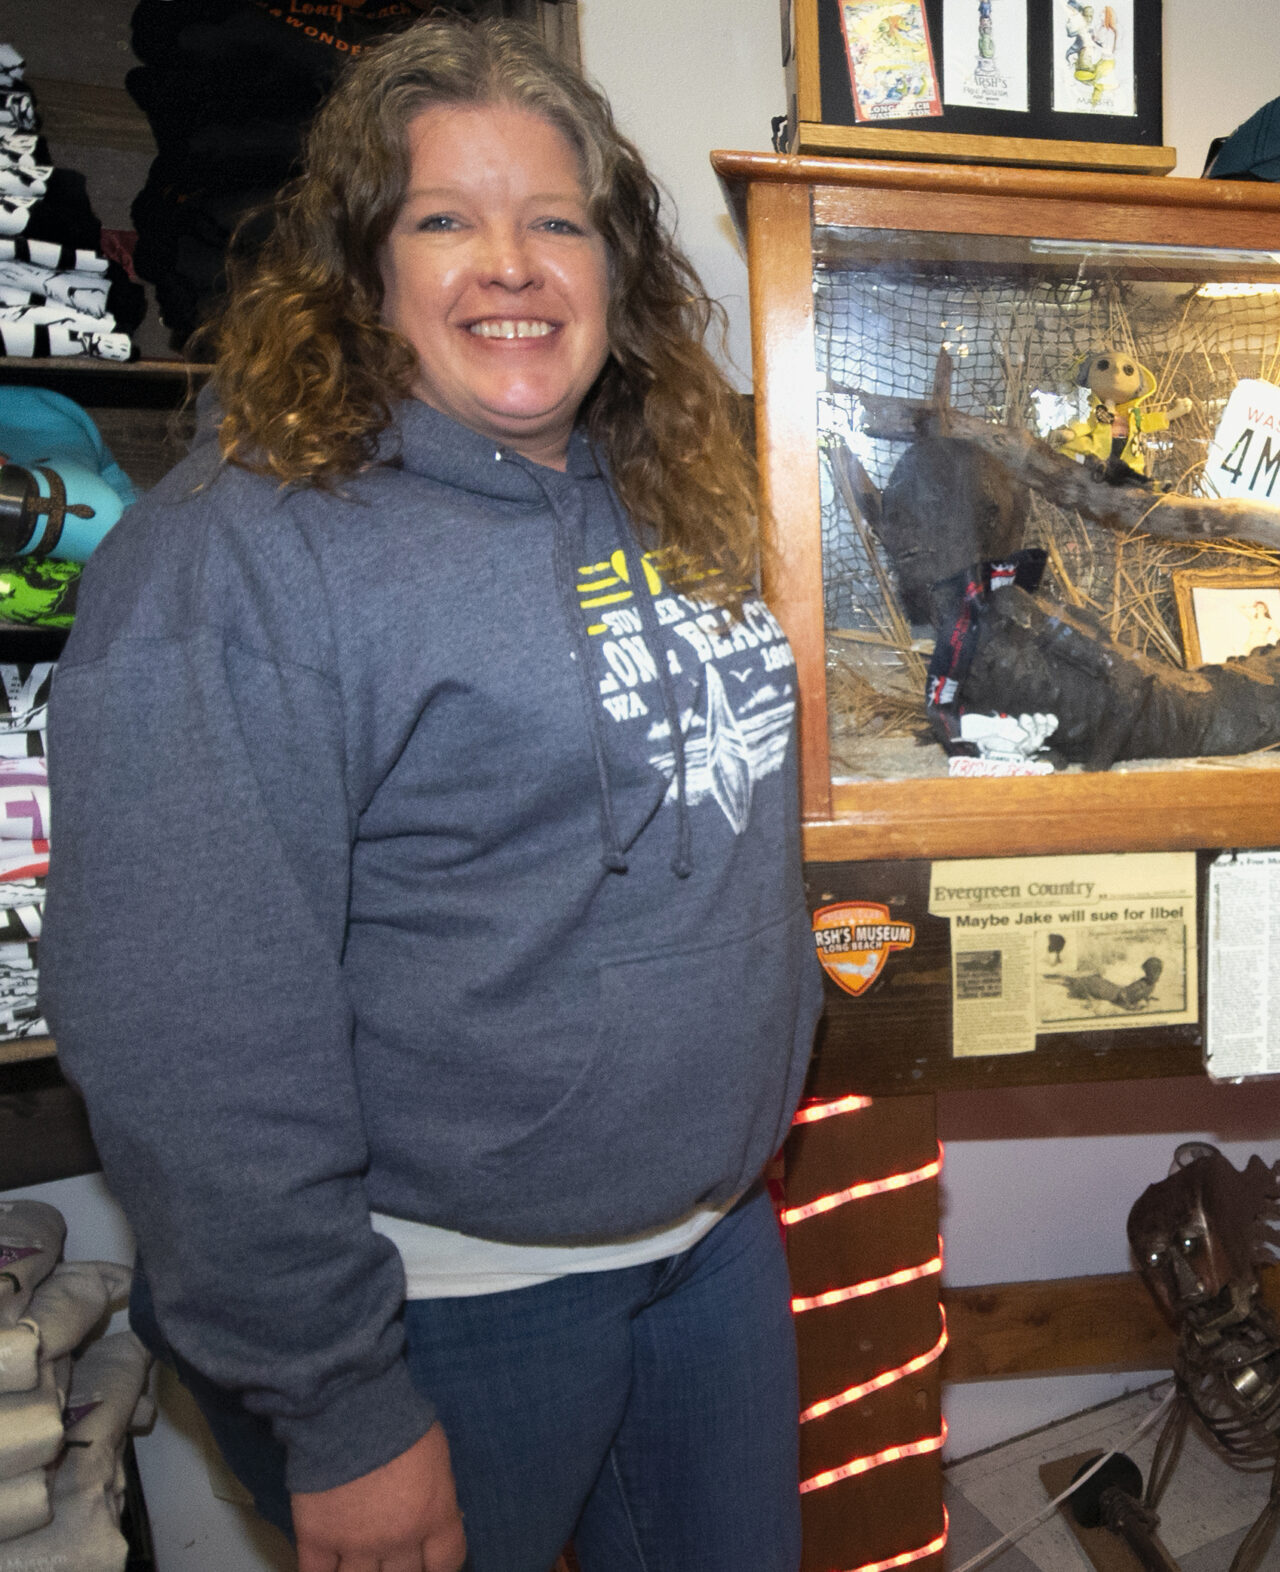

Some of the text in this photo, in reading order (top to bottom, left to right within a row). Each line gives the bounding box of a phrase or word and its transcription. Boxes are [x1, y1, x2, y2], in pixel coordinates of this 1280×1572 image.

[603, 692, 648, 722] WA
[934, 880, 1096, 903] Evergreen Country
[956, 906, 1184, 929] Maybe Jake will sue for libel
[815, 926, 911, 947] RSH'S MUSEUM
[823, 941, 883, 954] LONG BEACH
